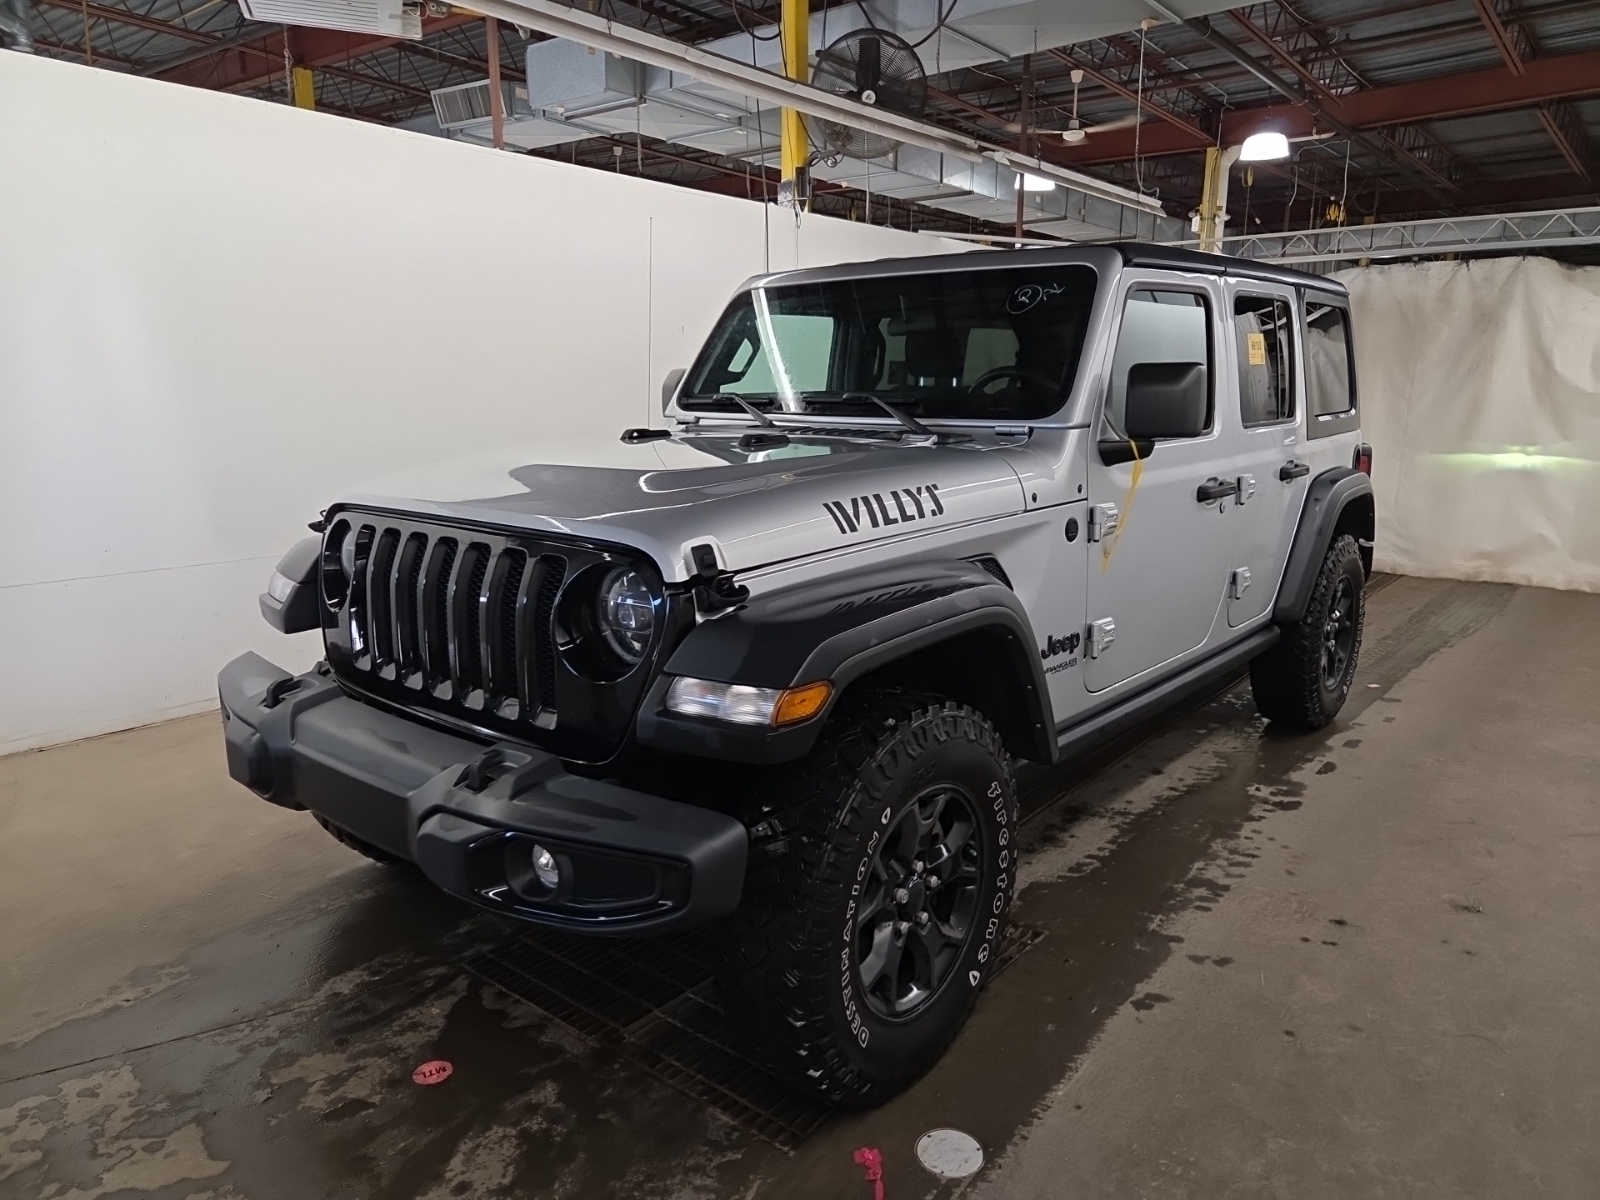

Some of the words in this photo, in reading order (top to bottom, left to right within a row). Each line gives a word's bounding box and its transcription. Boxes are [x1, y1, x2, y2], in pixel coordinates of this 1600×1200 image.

[822, 484, 944, 535] WILLYS
[1041, 631, 1080, 660] Jeep
[841, 831, 879, 1048] DESTINATION
